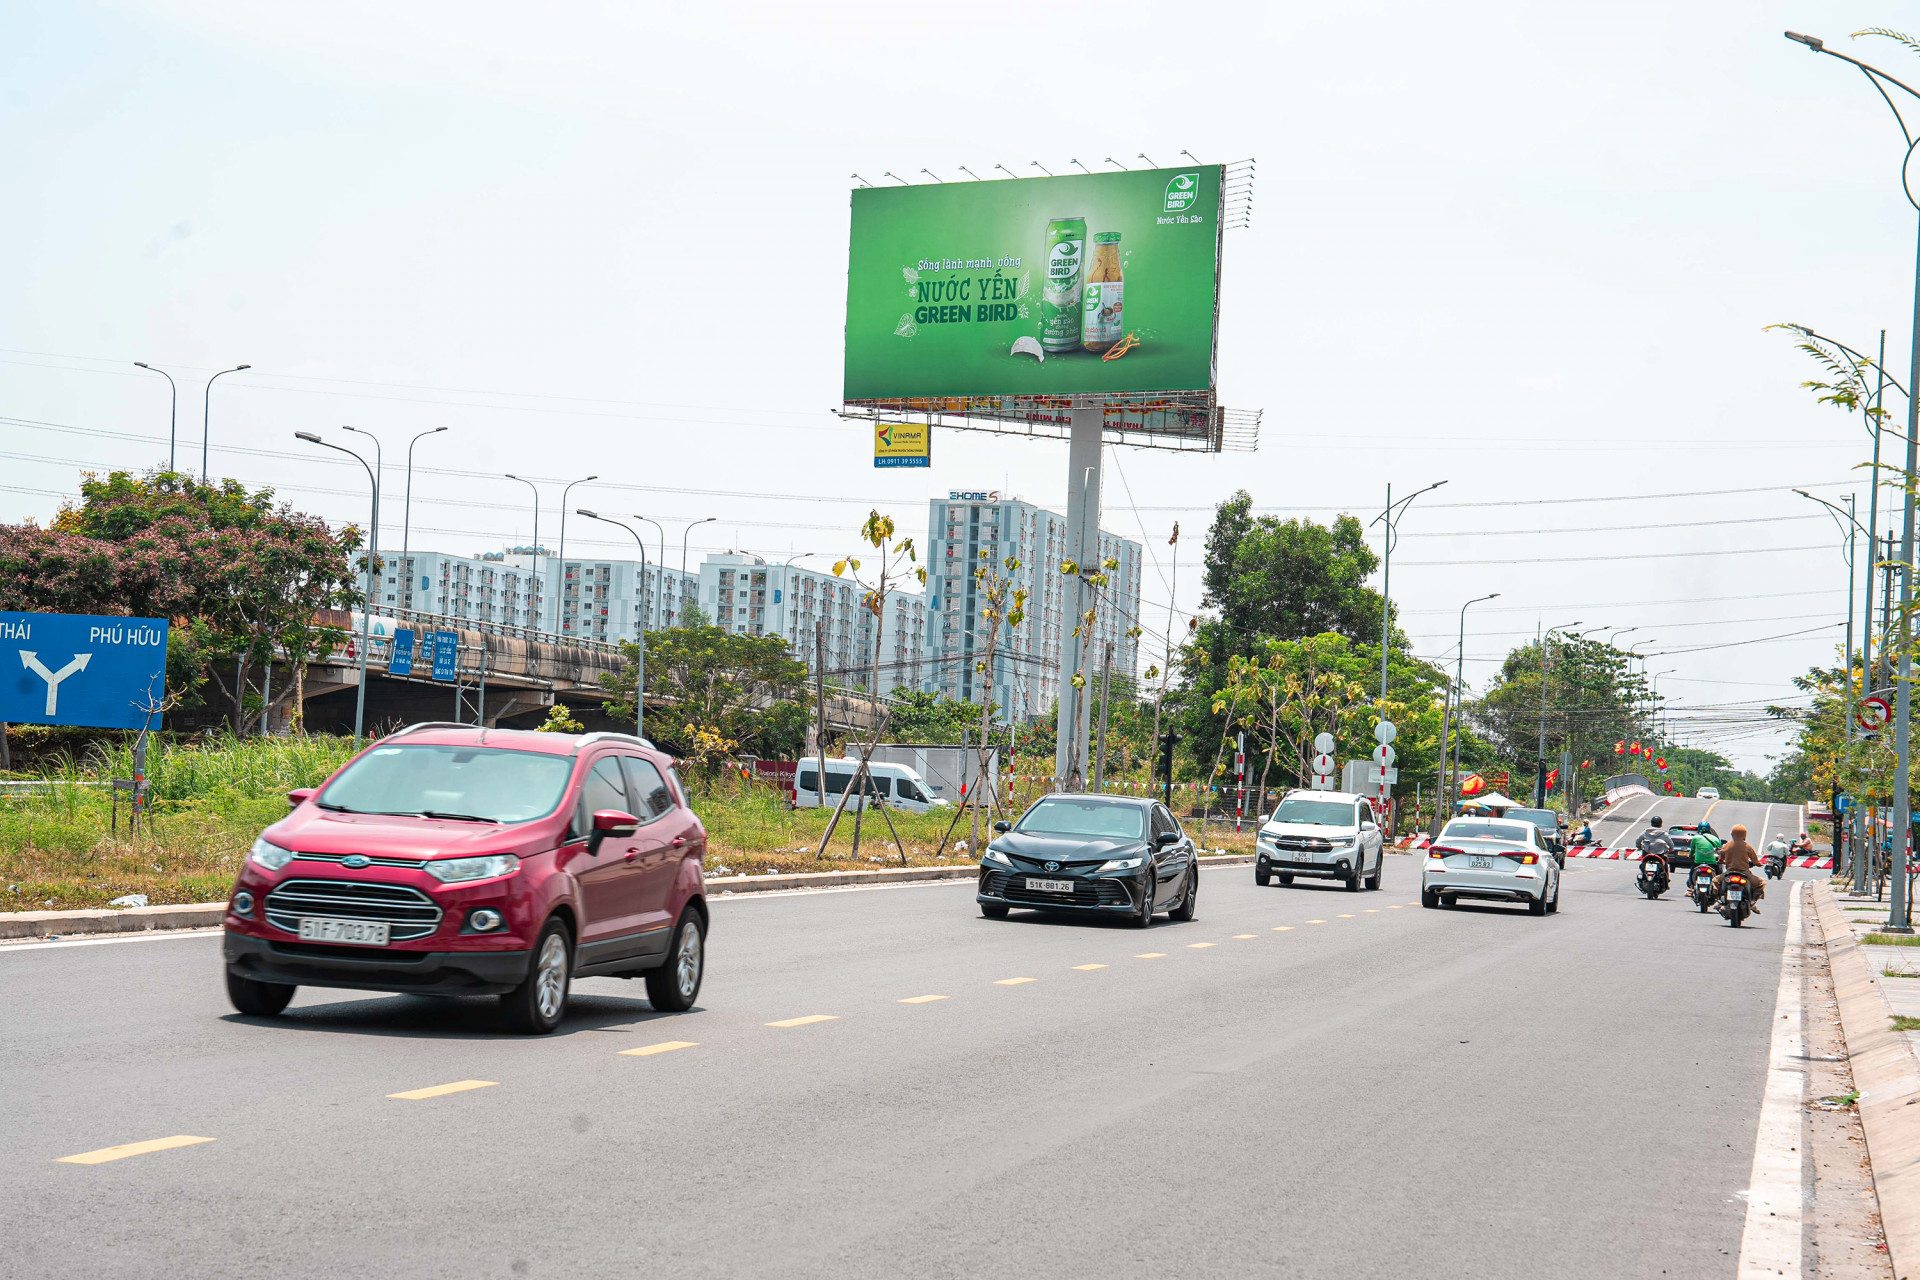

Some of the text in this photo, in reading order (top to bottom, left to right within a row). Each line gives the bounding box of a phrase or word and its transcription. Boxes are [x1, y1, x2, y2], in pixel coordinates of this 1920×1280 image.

[1168, 191, 1193, 200] GREEN
[1167, 200, 1185, 209] BIRD
[917, 257, 940, 273] Sống
[942, 258, 964, 270] lành
[966, 256, 995, 271] mạnh,
[1050, 258, 1079, 267] GREEN
[1050, 267, 1071, 276] BIRD
[917, 268, 1018, 303] NƯỚC YẾN
[914, 303, 1018, 324] GREEN BIRD
[949, 491, 987, 501] EHOME
[773, 589, 782, 604] B
[930, 595, 939, 610] A
[90, 624, 161, 646] PHÚ HỮU
[1030, 881, 1070, 890] 51K-881.26
